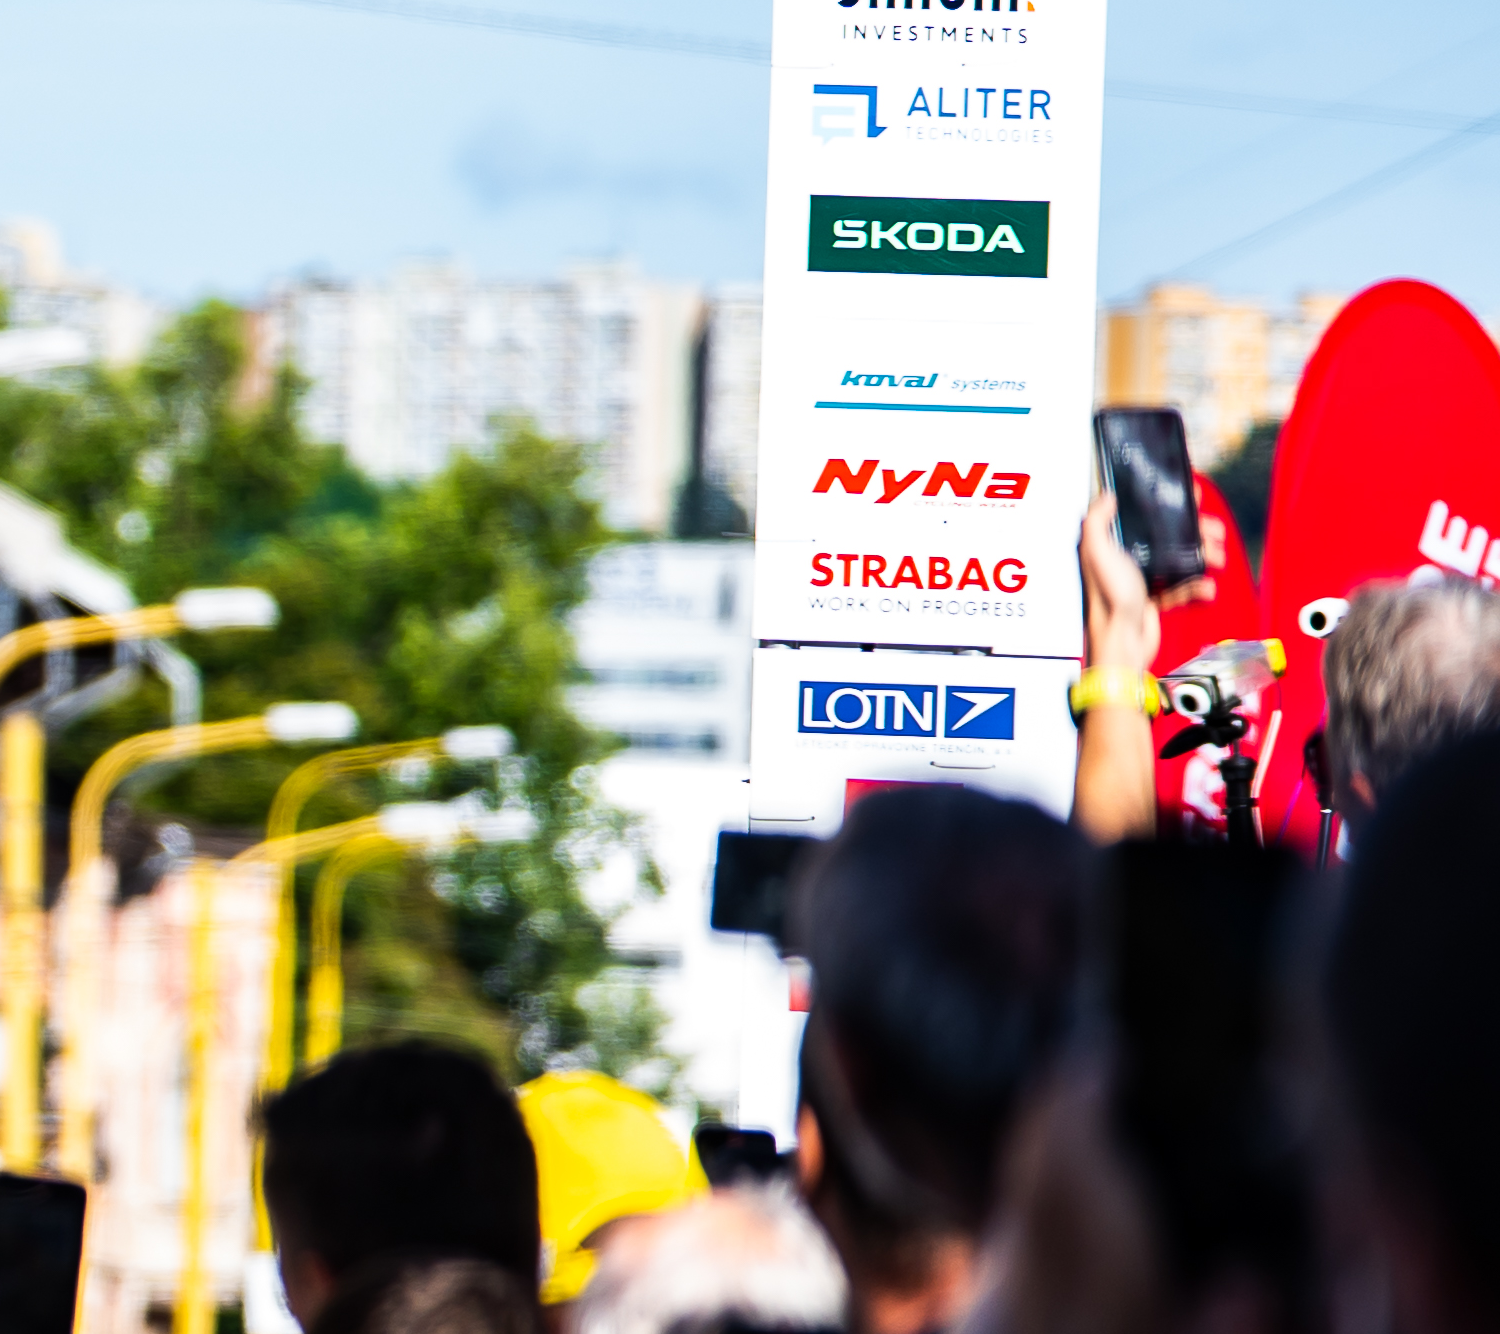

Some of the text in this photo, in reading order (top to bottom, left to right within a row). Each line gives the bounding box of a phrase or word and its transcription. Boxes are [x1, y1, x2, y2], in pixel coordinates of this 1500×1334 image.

[842, 25, 1028, 44] INVESTMENTS
[907, 85, 1052, 121] ALITER
[905, 126, 1054, 144] TECHNOLOGIES
[840, 370, 1027, 394] koval systems
[812, 458, 1031, 504] NyNa
[810, 552, 1028, 593] STRABAG
[808, 597, 1026, 617] WORK ON PROGRESS
[803, 687, 934, 732] LOTN
